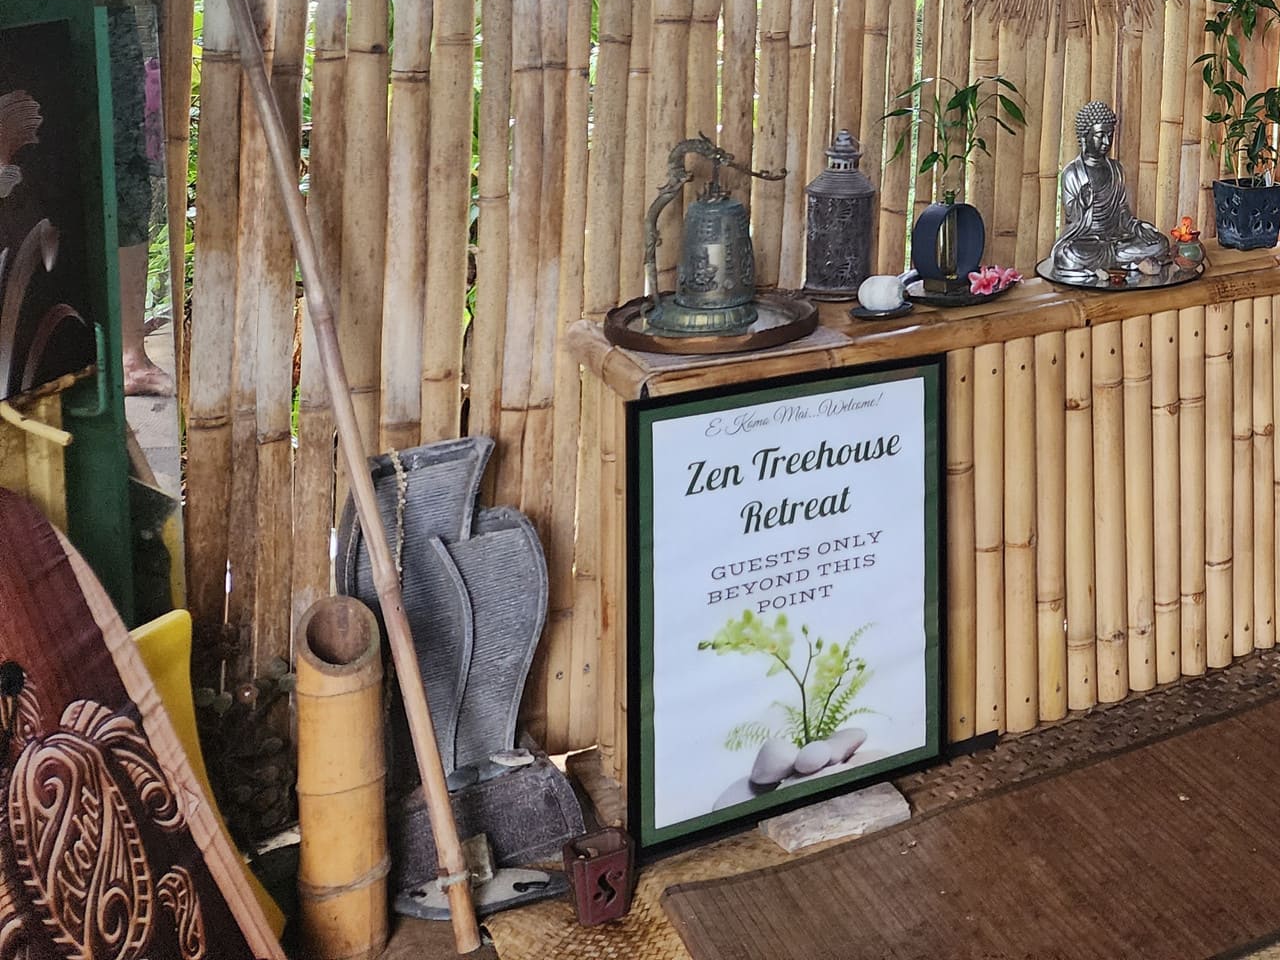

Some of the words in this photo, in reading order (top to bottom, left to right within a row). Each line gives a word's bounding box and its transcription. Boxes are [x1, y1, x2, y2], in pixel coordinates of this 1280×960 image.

[705, 418, 721, 437] E
[725, 414, 769, 435] Komo
[685, 460, 744, 496] Zen
[752, 434, 902, 481] Treehouse
[740, 486, 851, 534] Retreat
[707, 568, 810, 605] BEYOND
[817, 553, 876, 577] THIS
[711, 546, 810, 580] GUESTS
[817, 530, 883, 555] ONLY
[757, 584, 833, 614] POINT
[56, 785, 99, 924] Aloha
